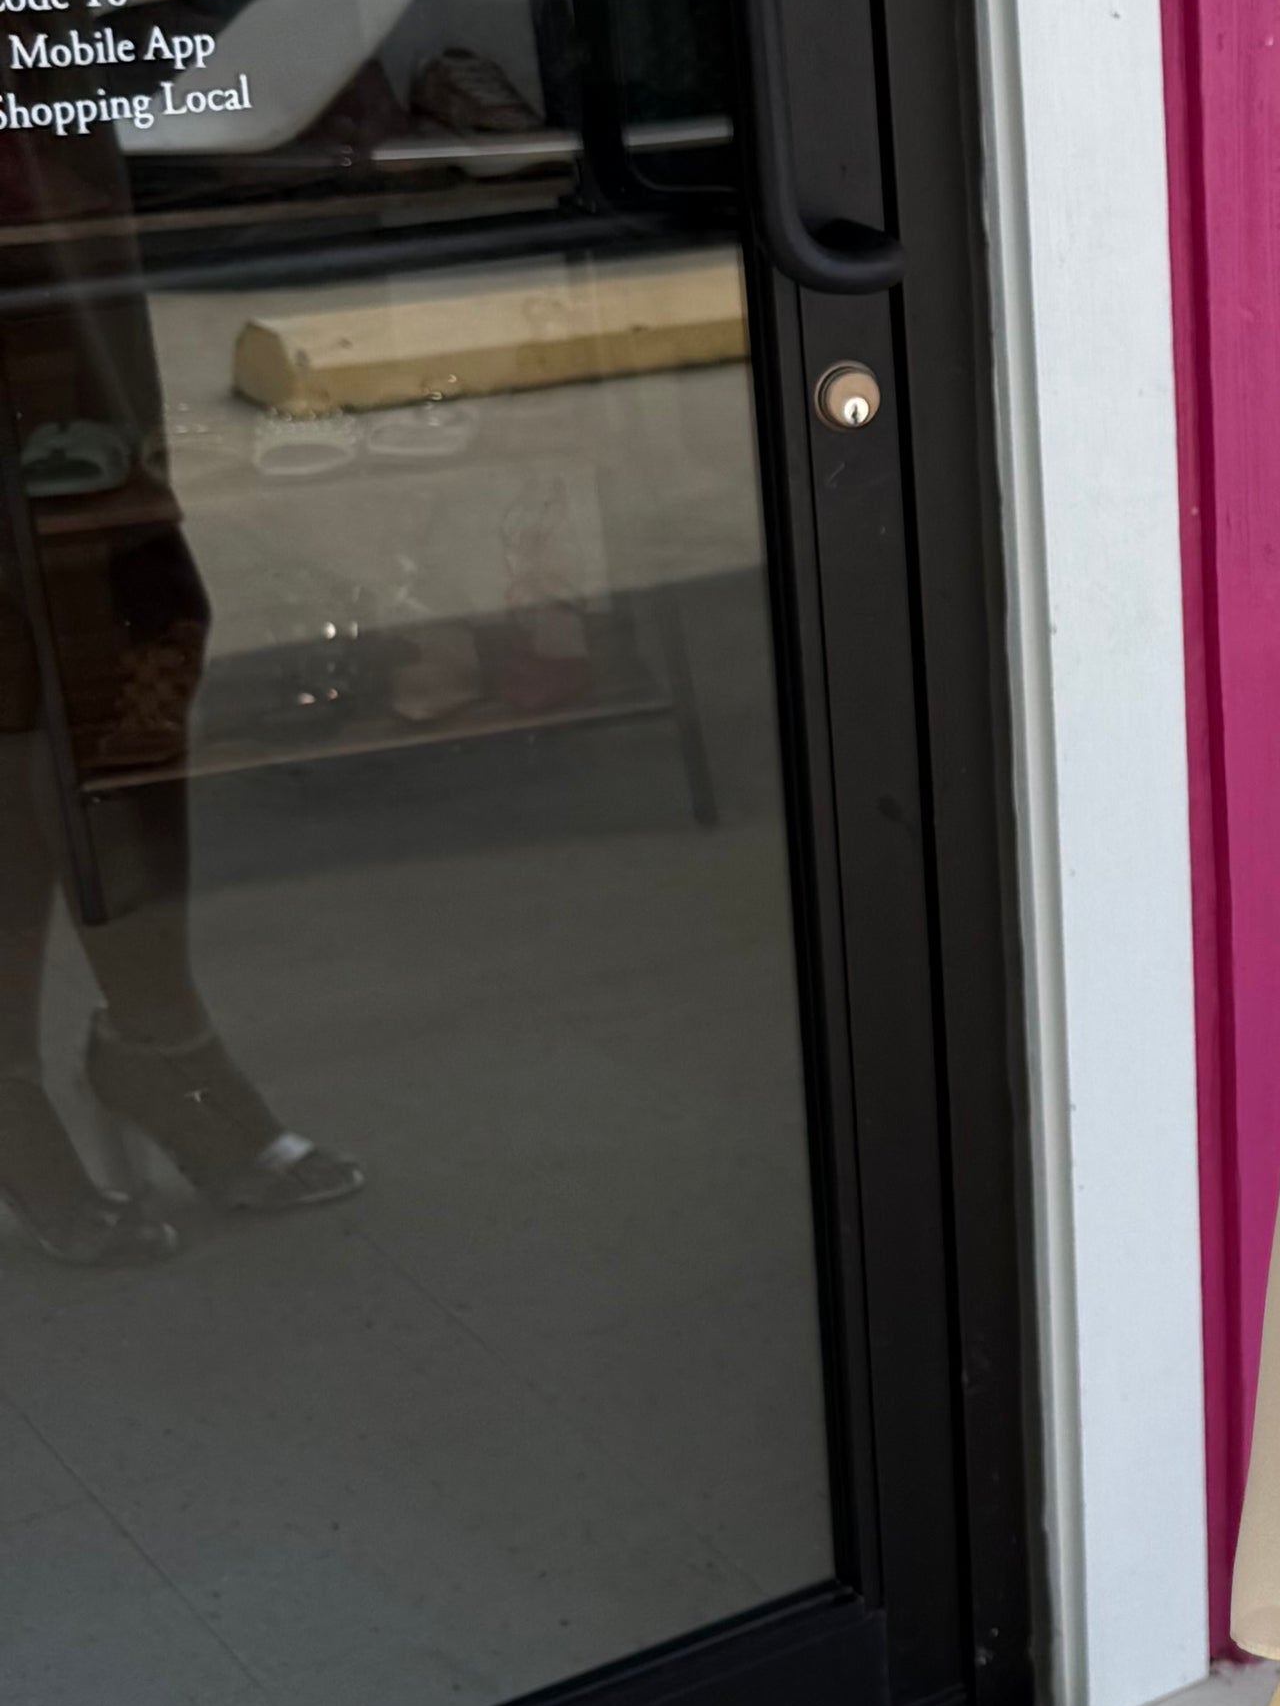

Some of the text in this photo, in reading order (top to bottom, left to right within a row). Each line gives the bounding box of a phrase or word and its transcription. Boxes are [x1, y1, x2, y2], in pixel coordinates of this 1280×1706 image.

[8, 24, 216, 70] Mobile App
[160, 73, 253, 116] Local
